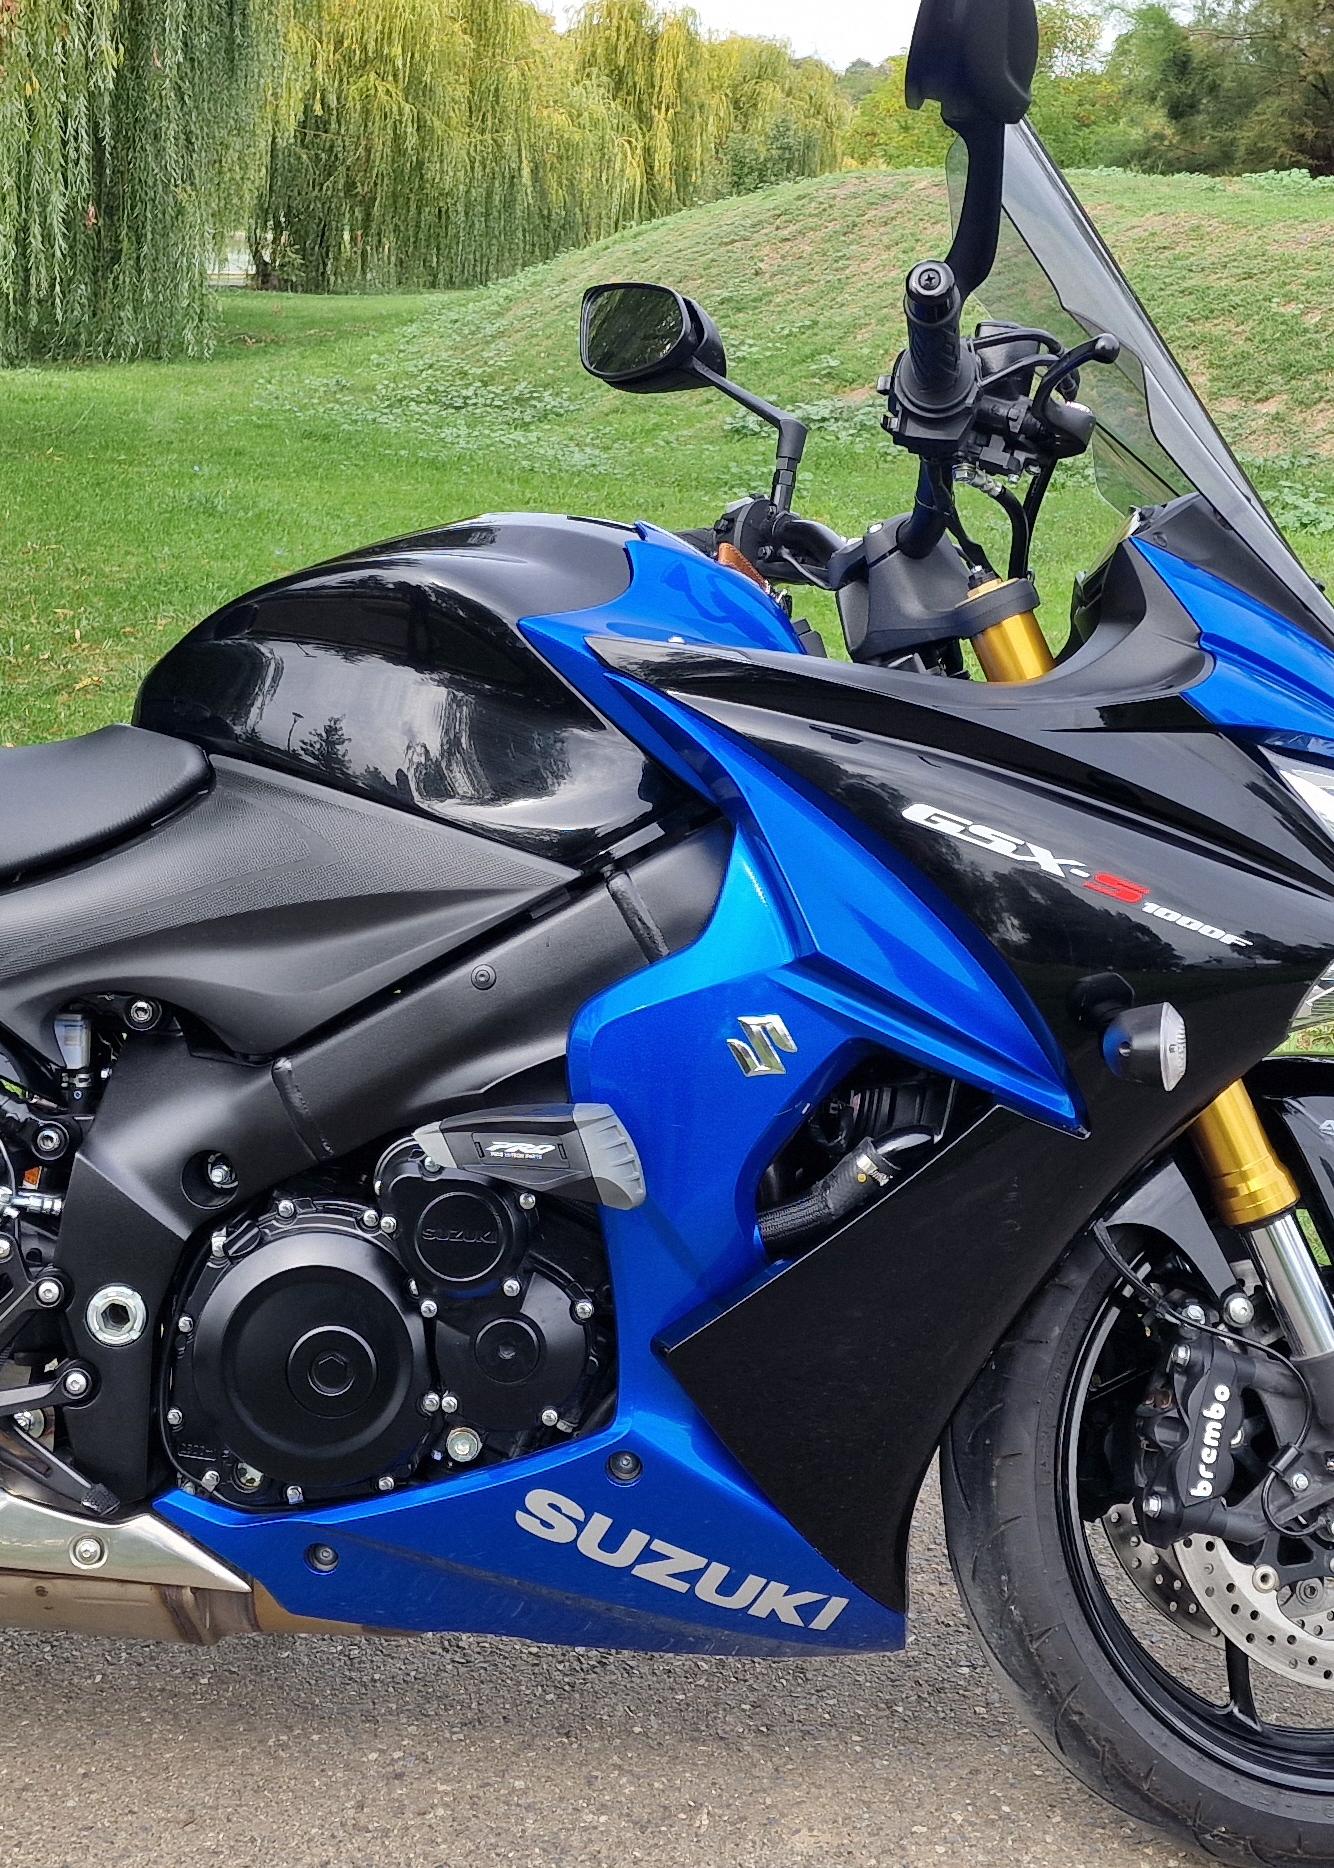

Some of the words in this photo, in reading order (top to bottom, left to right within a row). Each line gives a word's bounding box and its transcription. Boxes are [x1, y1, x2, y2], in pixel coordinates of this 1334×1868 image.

[902, 803, 1151, 904] GSX-S
[1141, 902, 1255, 948] 1000F
[422, 1228, 497, 1244] SUZUKI
[1189, 1384, 1231, 1498] brembo
[515, 1489, 849, 1631] SUZUKI
